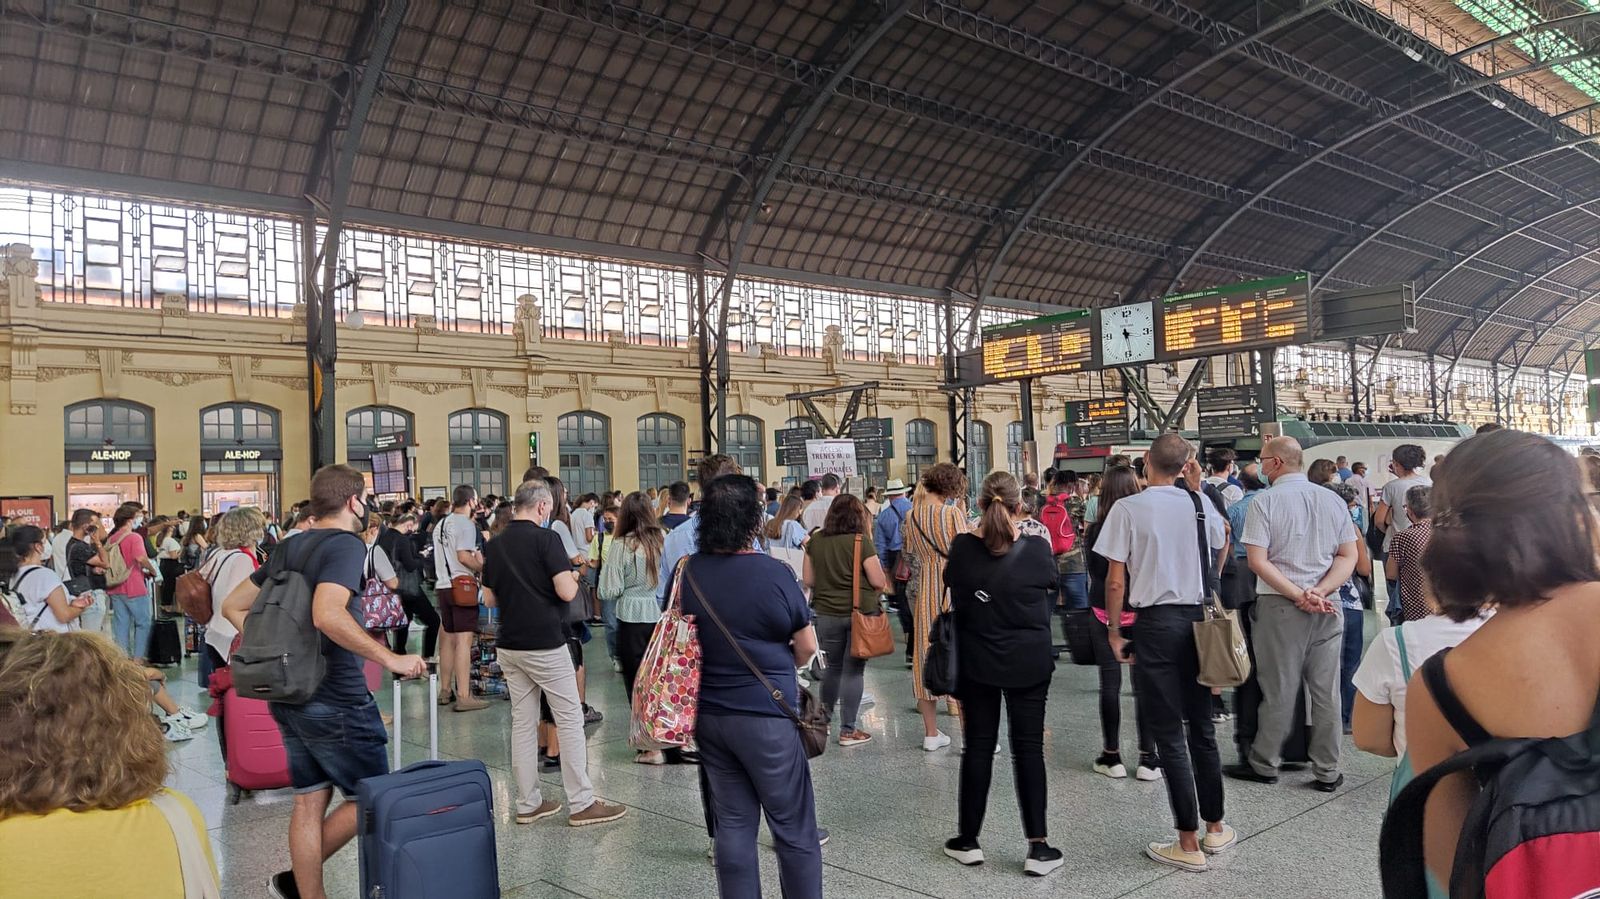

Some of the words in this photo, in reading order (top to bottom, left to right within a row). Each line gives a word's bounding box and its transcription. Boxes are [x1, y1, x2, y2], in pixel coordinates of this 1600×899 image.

[1122, 310, 1132, 318] 12
[1143, 327, 1150, 336] 3
[1106, 333, 1112, 341] 9
[1125, 350, 1132, 358] 6
[1249, 397, 1258, 407] 4
[1078, 412, 1085, 421] 3
[878, 428, 883, 437] 2
[1251, 425, 1259, 436] 4
[782, 438, 786, 446] 1
[1079, 437, 1086, 447] 3
[91, 450, 132, 461] ALE-HOP
[225, 450, 261, 461] ALE-HOP
[879, 450, 884, 458] 2
[814, 466, 853, 474] REGIONALES
[16, 508, 34, 516] QUE
